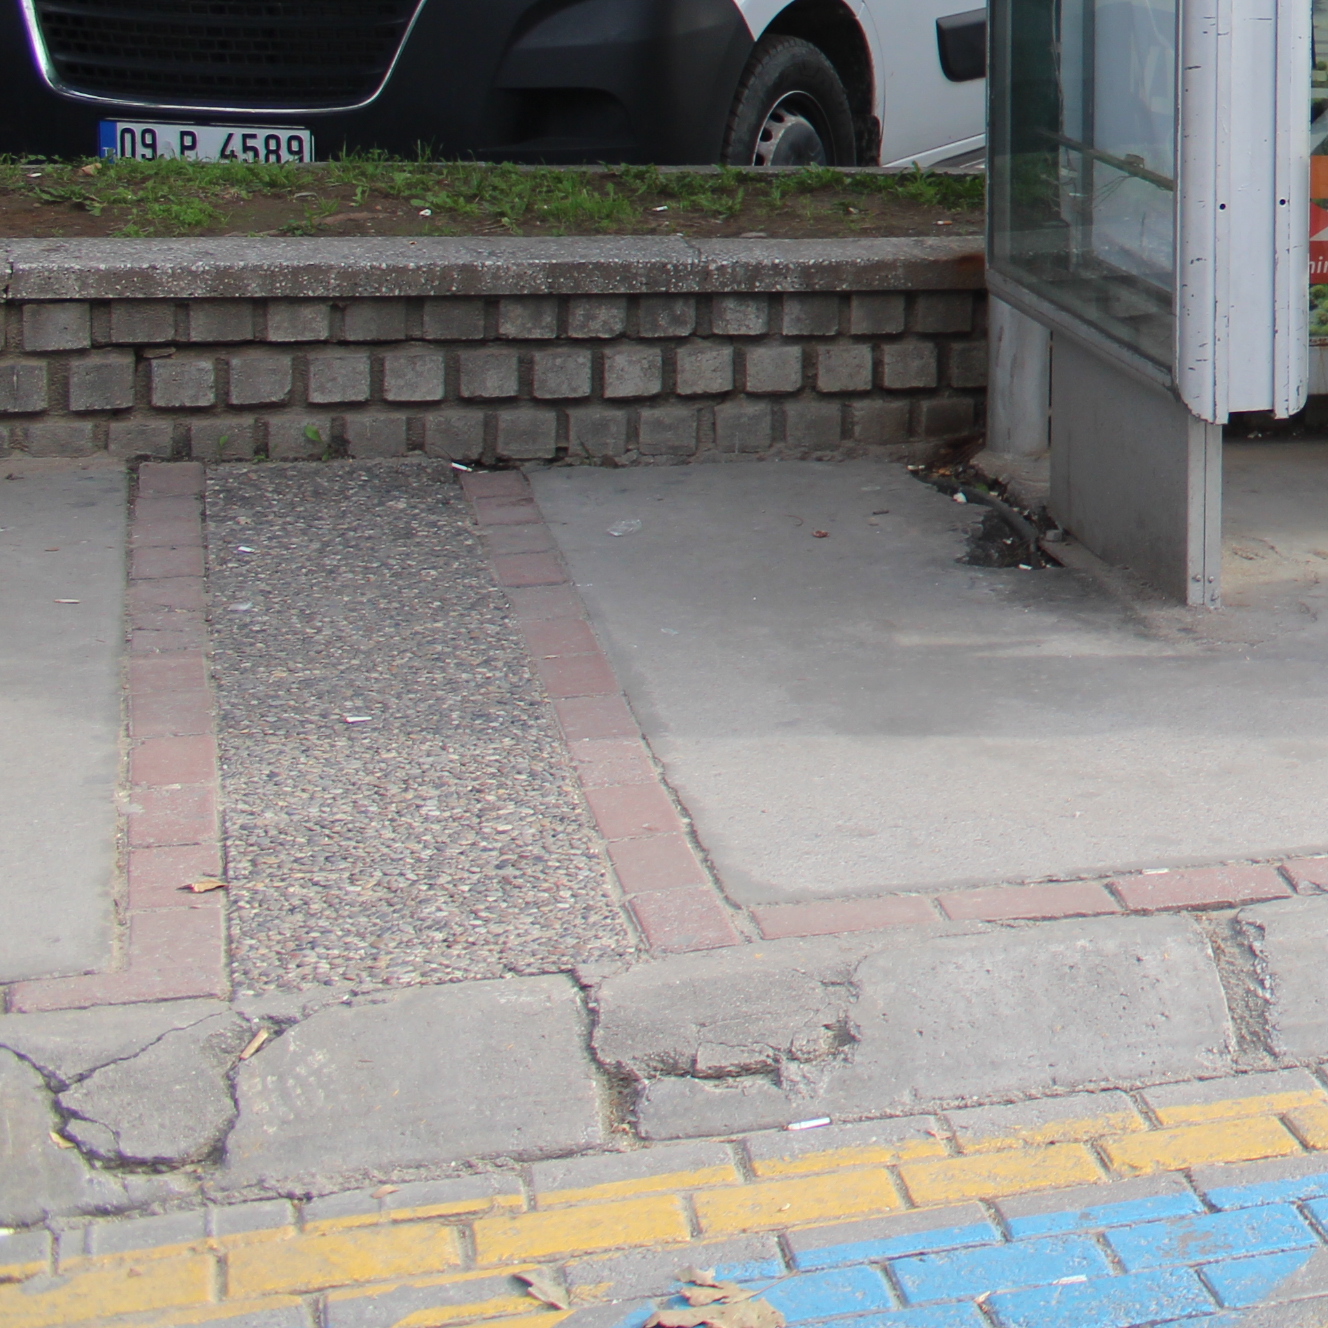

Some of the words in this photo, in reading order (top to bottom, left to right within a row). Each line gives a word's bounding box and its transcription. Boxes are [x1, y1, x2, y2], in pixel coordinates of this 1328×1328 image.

[120, 128, 158, 161] 09
[180, 129, 198, 161] P
[220, 132, 305, 164] 4589
